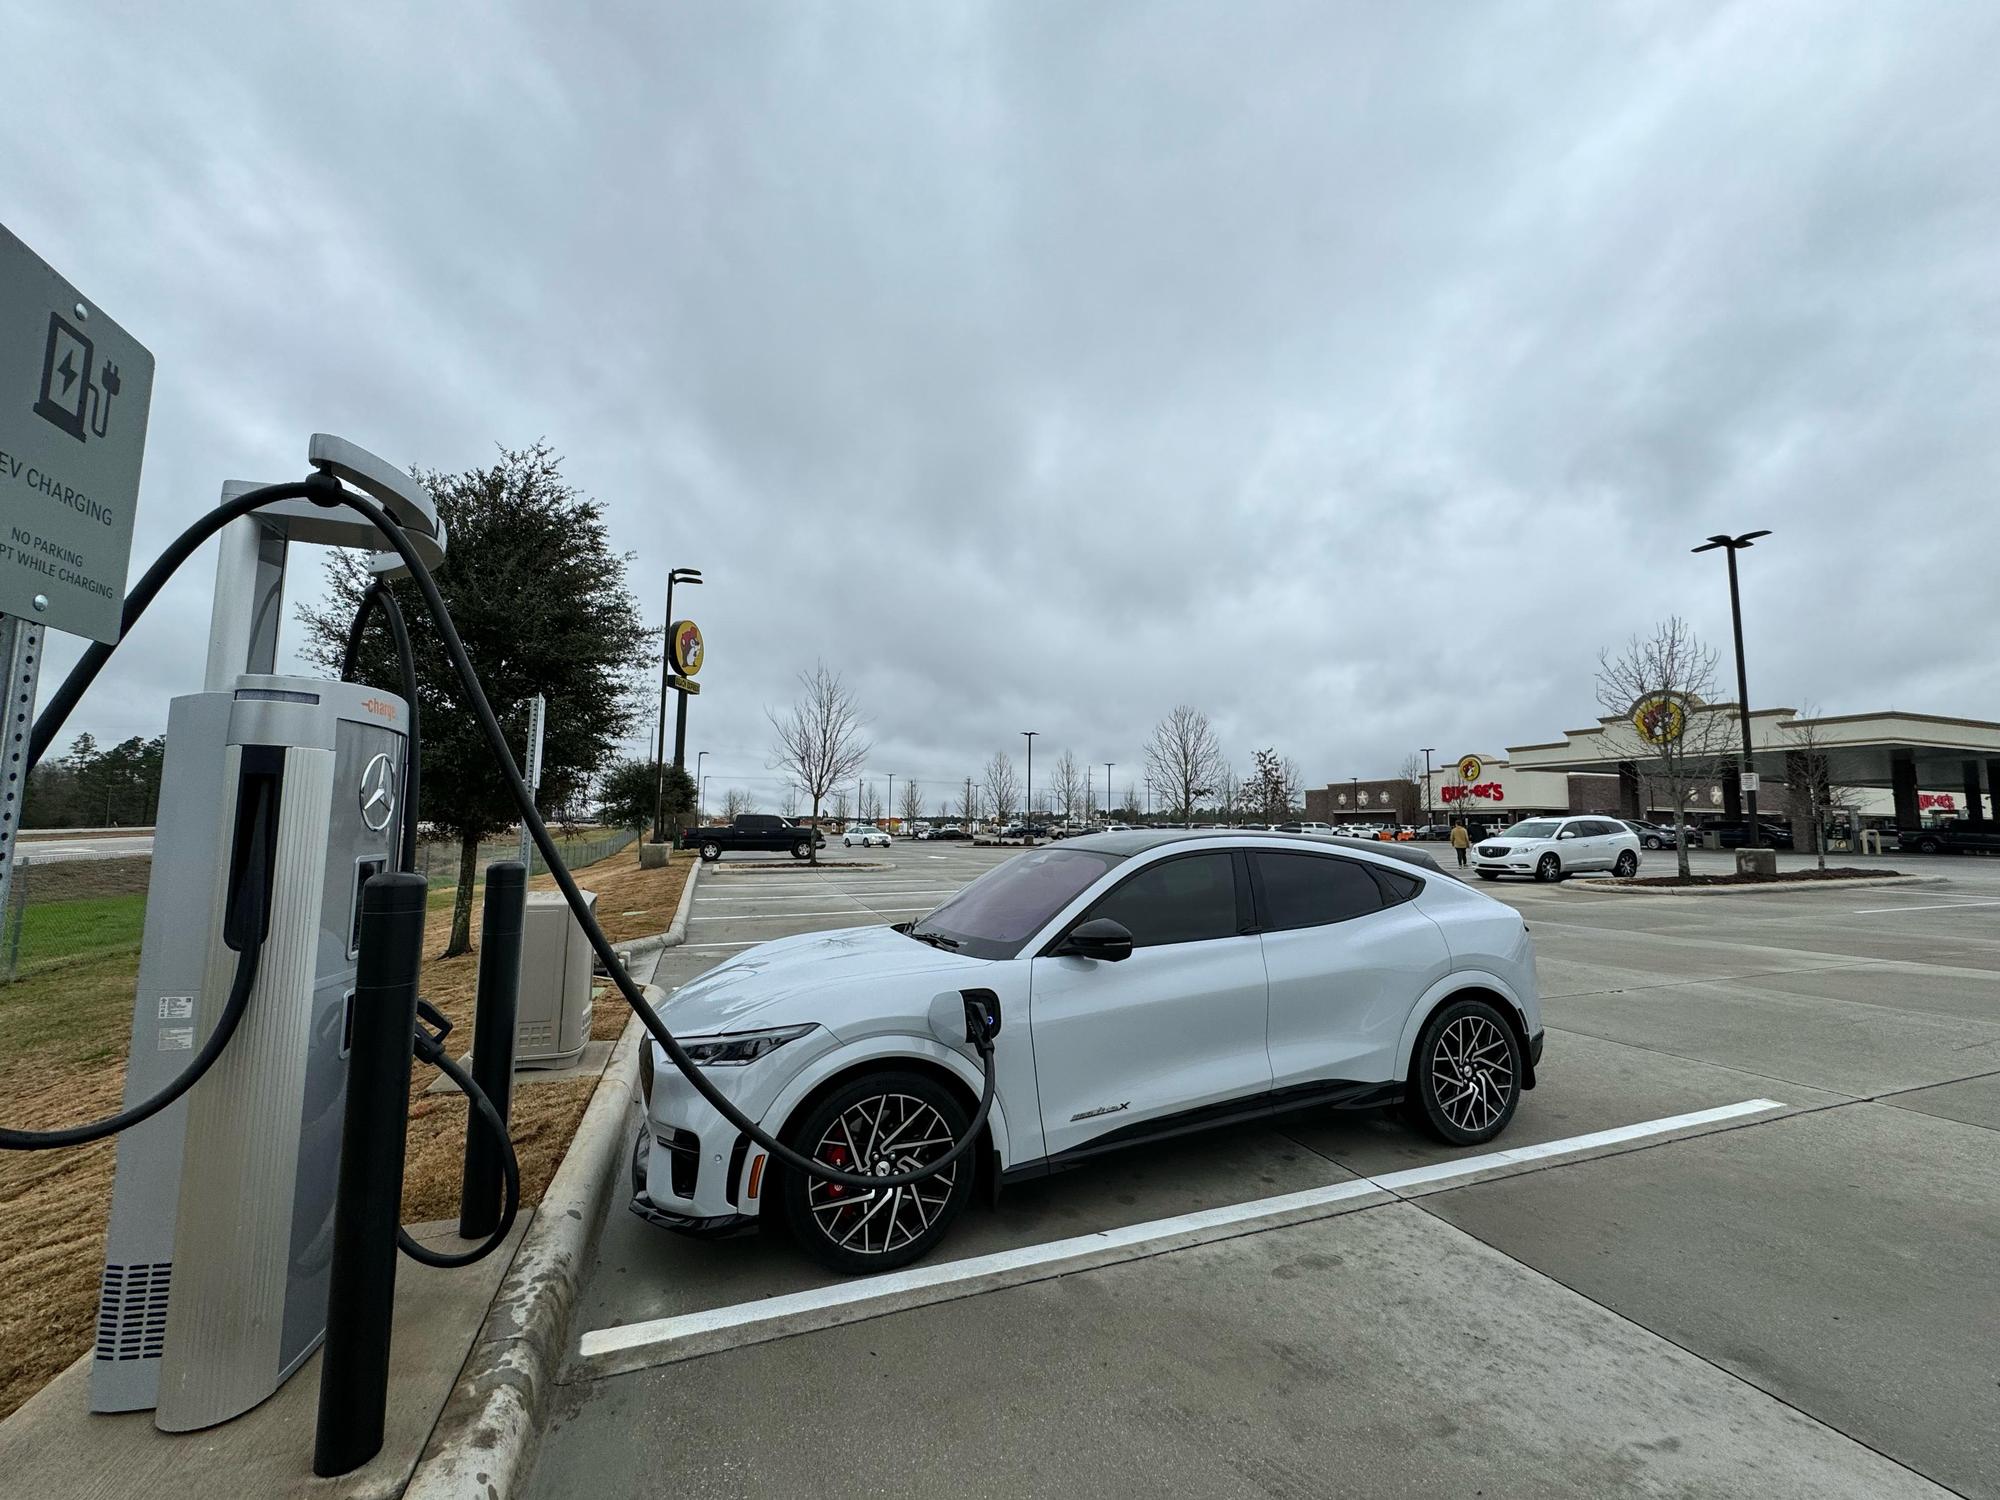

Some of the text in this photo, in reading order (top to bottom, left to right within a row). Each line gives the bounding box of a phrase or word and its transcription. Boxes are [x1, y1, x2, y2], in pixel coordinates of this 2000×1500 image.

[0, 451, 112, 526] EV CHARGING
[11, 527, 83, 567] NO PARKING
[17, 550, 56, 577] WHILE
[59, 568, 113, 599] CHARGING
